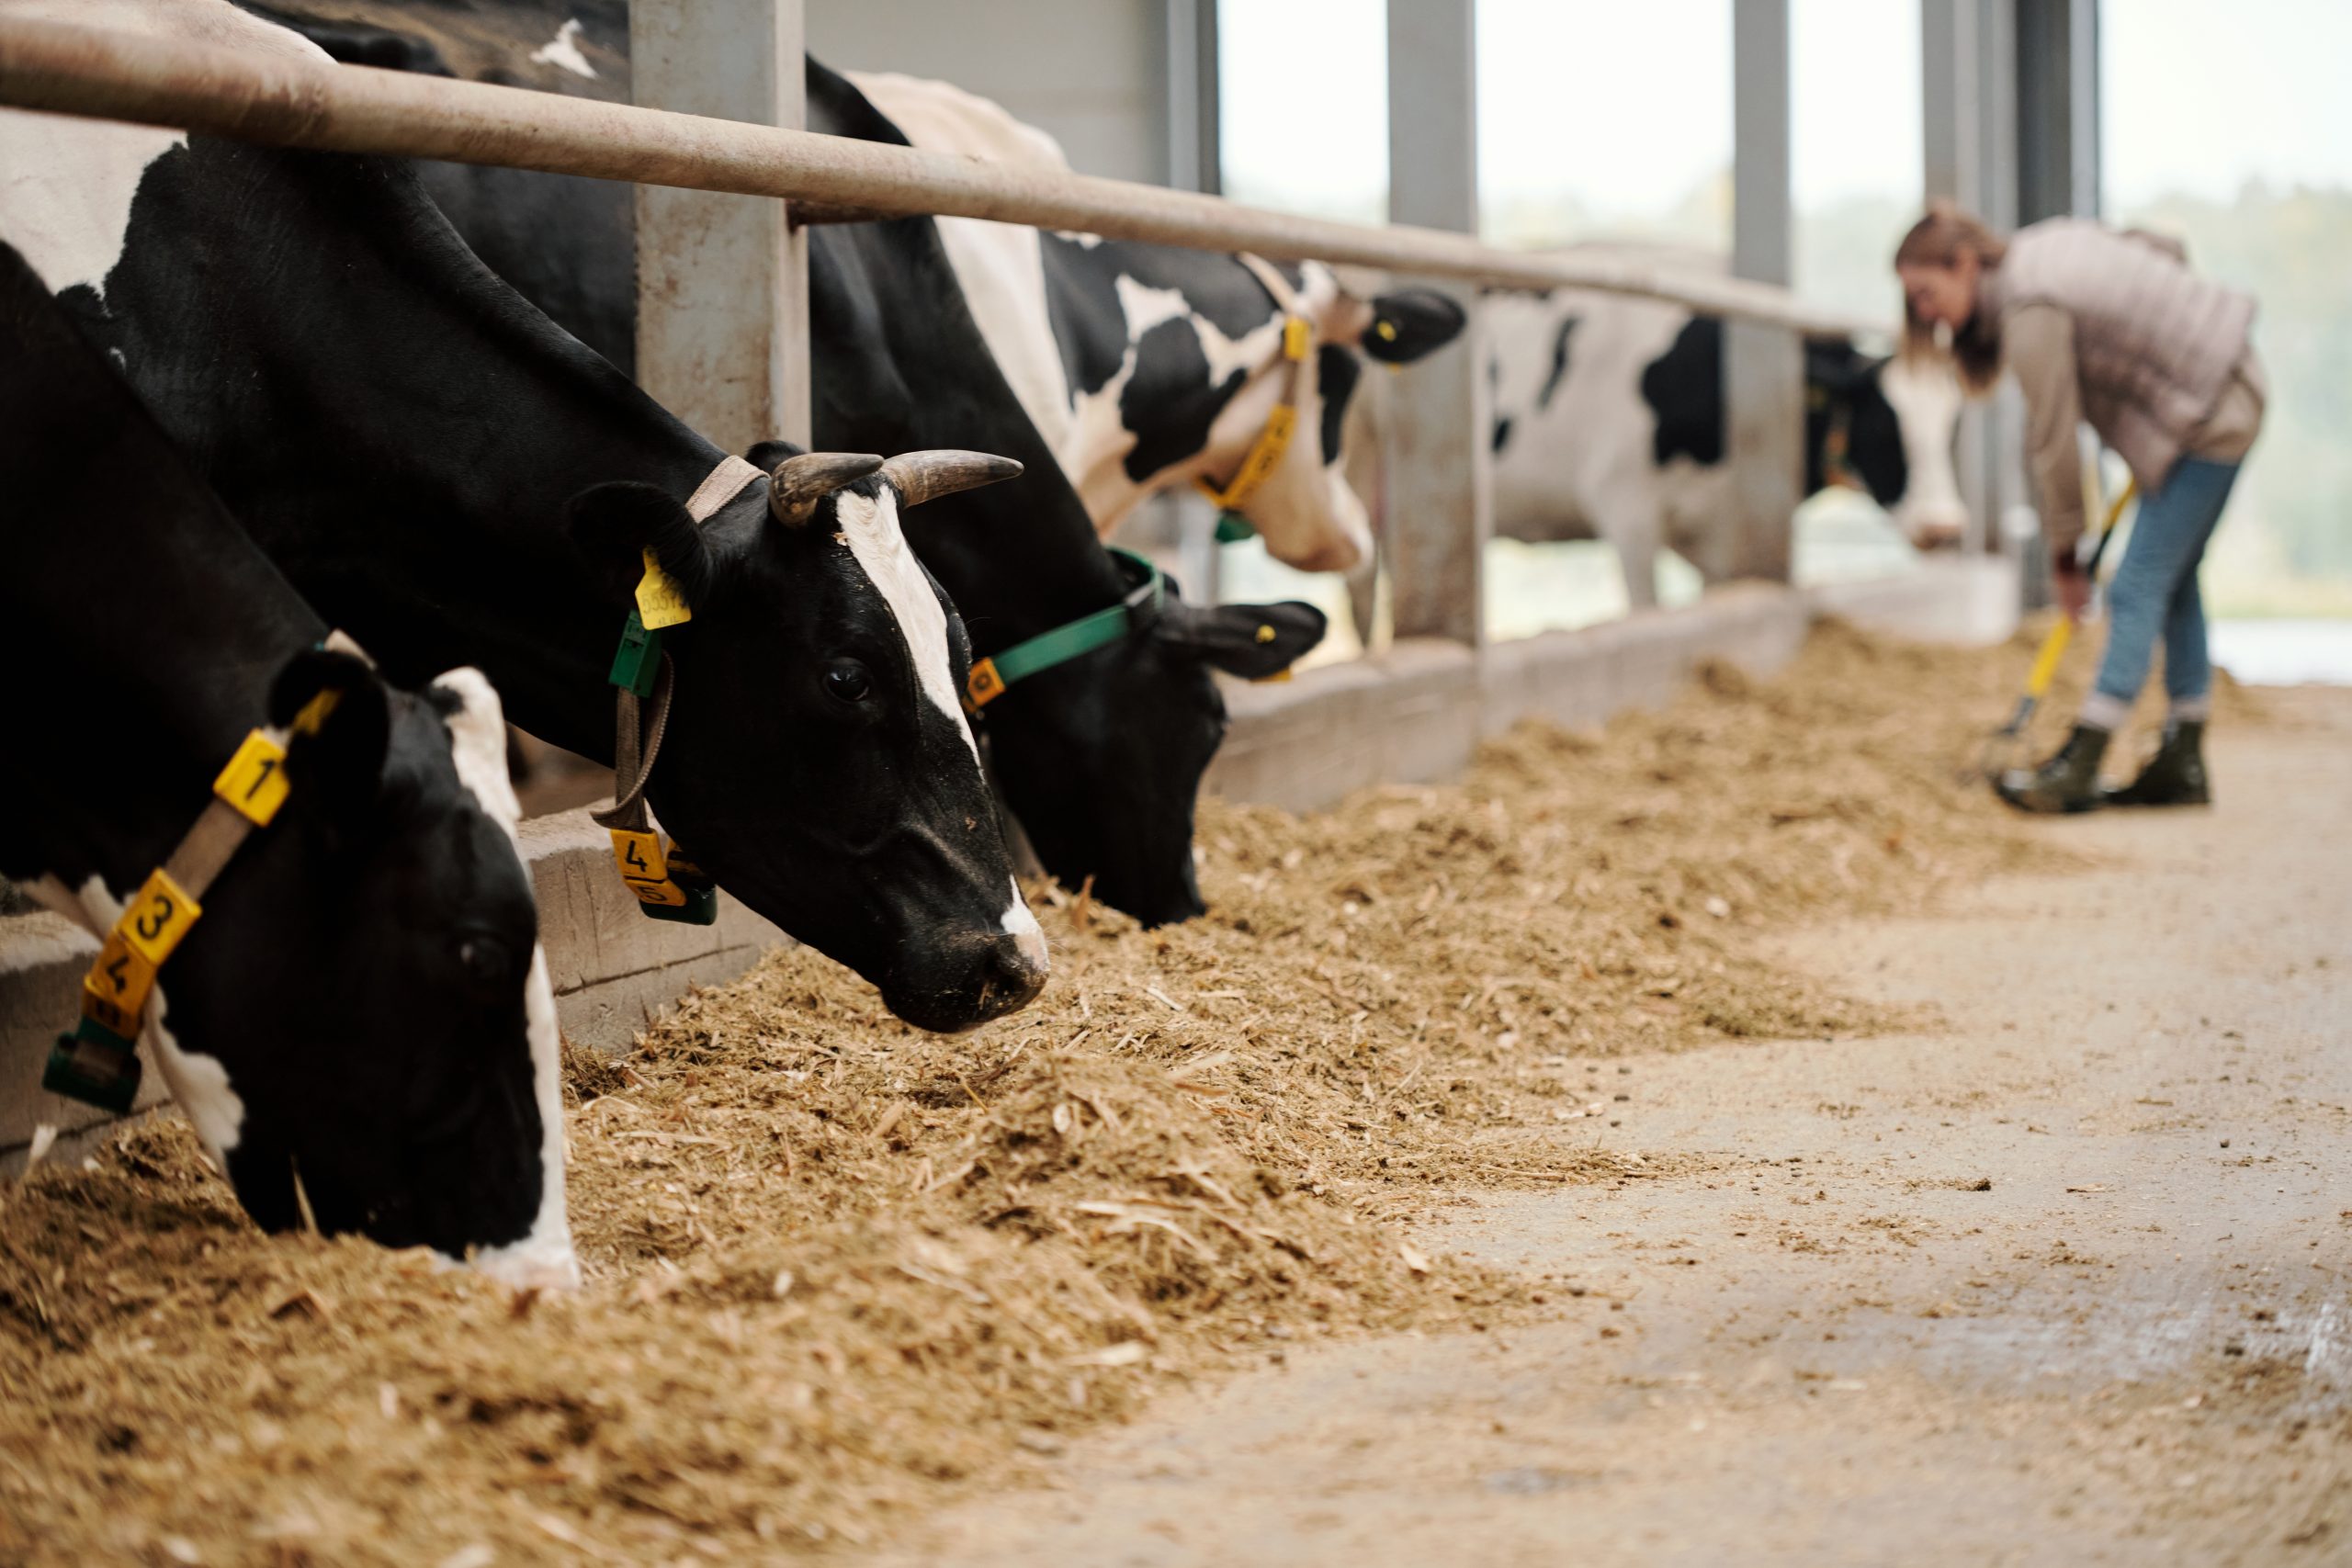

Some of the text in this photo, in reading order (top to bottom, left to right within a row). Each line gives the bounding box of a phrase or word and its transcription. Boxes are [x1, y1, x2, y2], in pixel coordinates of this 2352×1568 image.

[244, 759, 277, 802] 1
[626, 840, 648, 873] 4
[137, 896, 174, 941] 3
[106, 955, 130, 994] 4
